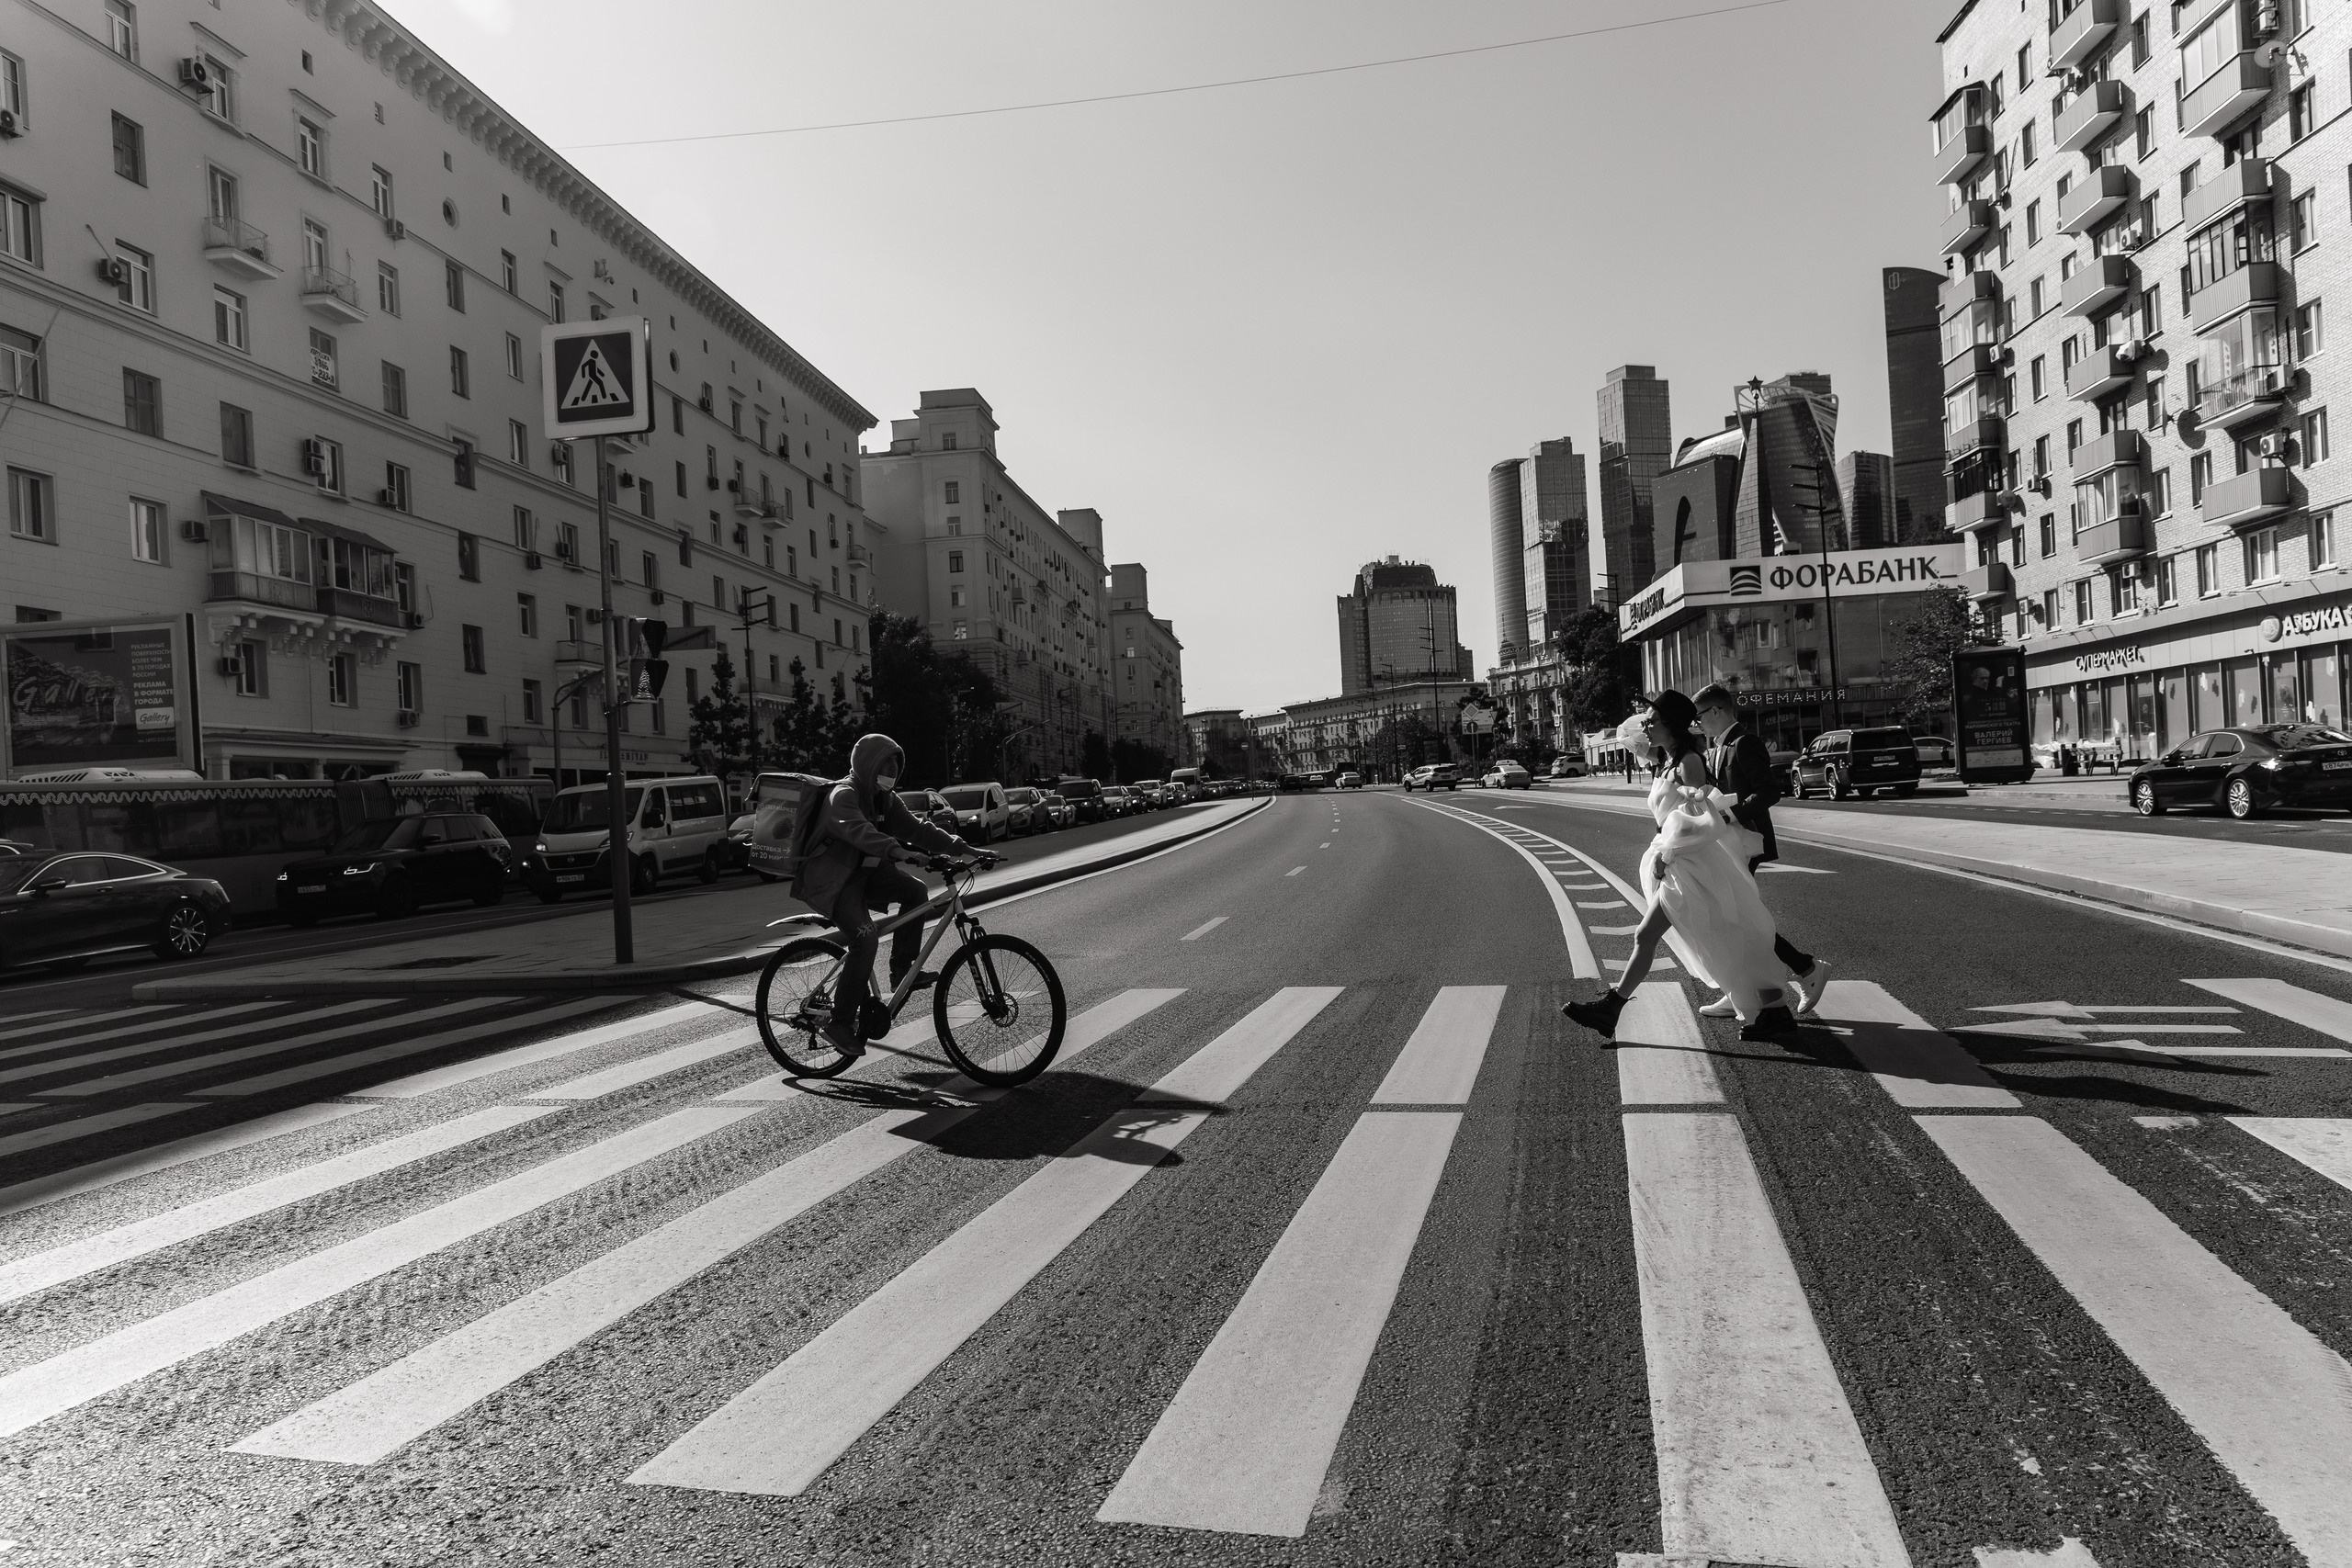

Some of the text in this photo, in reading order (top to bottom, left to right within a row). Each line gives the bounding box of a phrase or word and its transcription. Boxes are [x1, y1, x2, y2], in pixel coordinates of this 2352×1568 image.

[1770, 556, 1939, 590] ФОРАБАНК
[2282, 605, 2345, 635] АЗБУКА
[2075, 645, 2139, 672] СУПЕРМАРКЕТ
[134, 681, 166, 689] РЕКЛАМА
[1736, 689, 1845, 706] ОФЕМАНИЯ
[140, 713, 170, 724] Gallery
[1974, 728, 2013, 739] ВАЛЕРИЙ
[1976, 737, 2012, 745] ГЕРГИЕВ
[752, 842, 782, 852] Доставка
